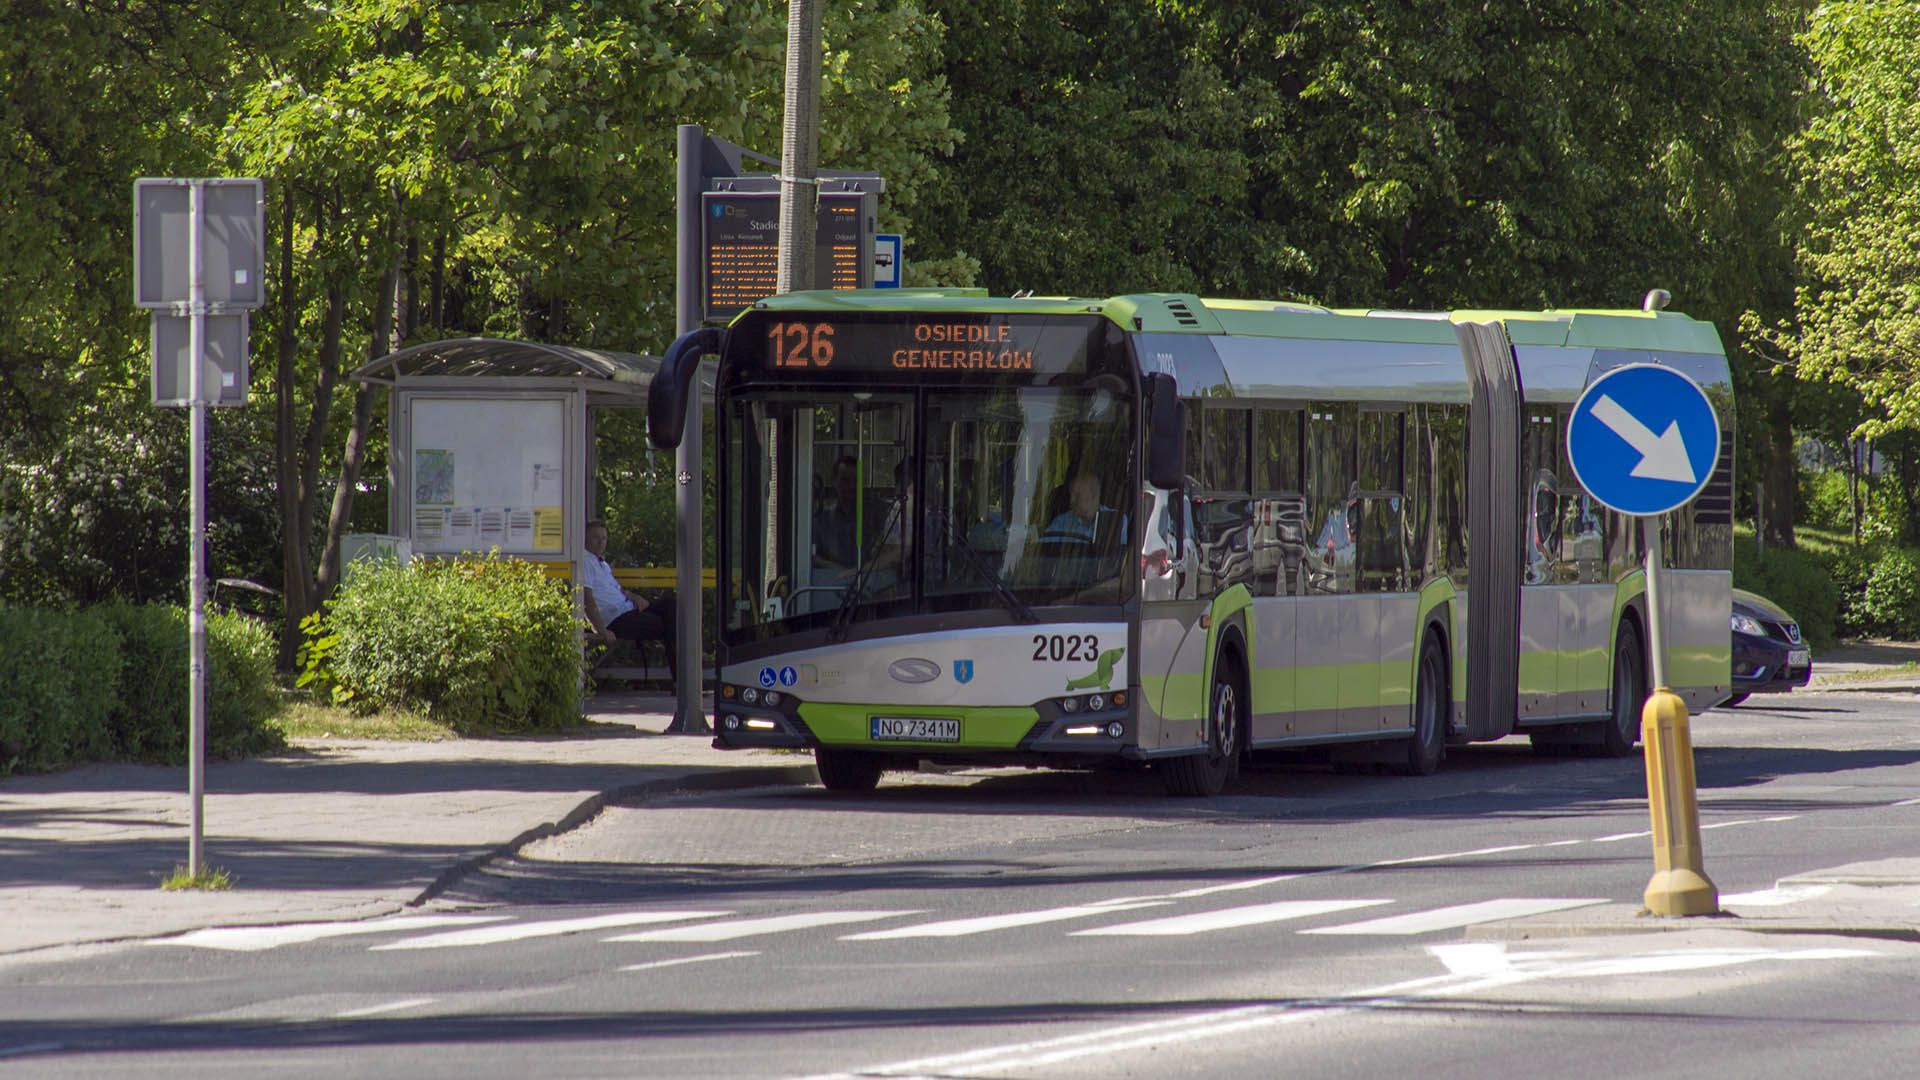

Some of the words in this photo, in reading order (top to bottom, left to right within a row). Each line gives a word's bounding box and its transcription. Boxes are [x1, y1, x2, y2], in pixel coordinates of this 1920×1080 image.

[750, 219, 780, 231] Stadio
[914, 324, 1011, 342] OSIEDLE
[768, 322, 835, 366] 126
[892, 349, 1032, 369] GENERAŁÓW
[1032, 634, 1099, 662] 2023
[881, 720, 904, 735] NO
[908, 720, 956, 737] 7341M
